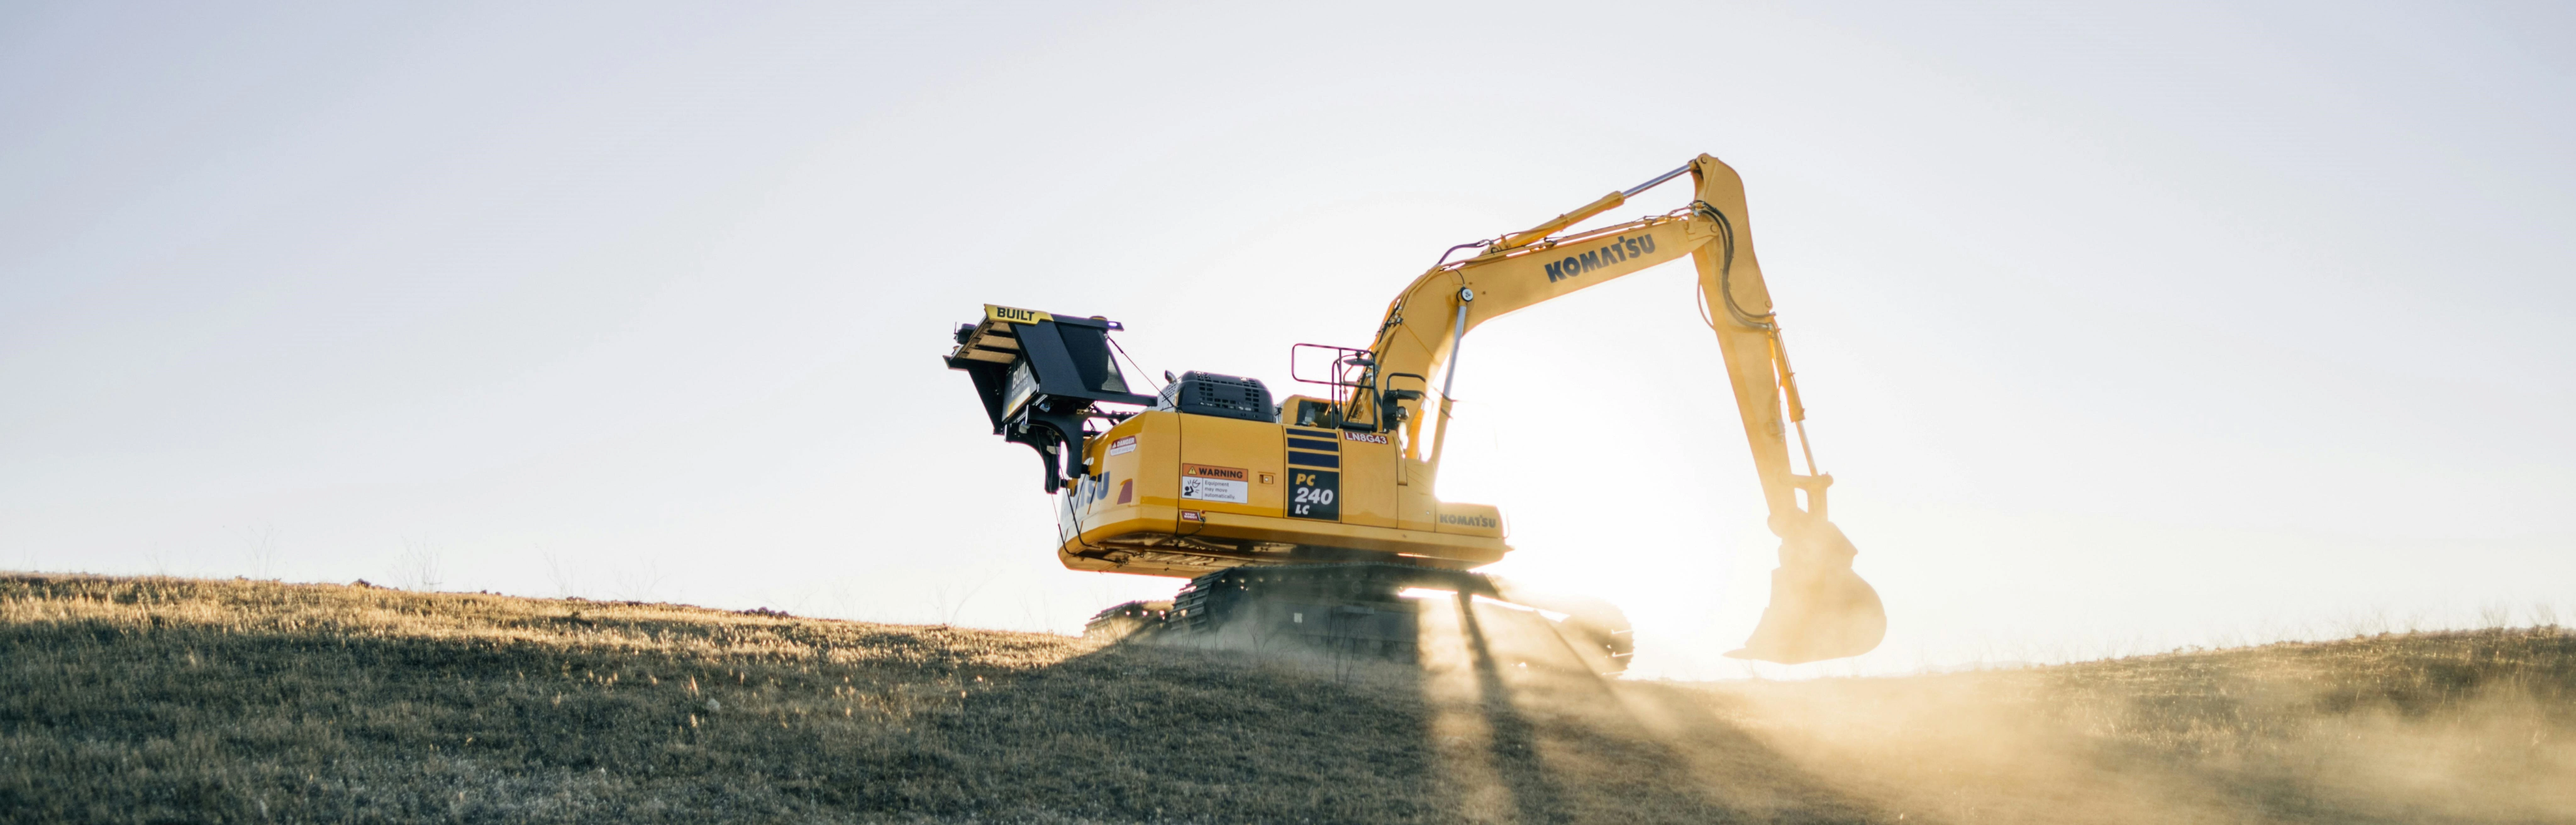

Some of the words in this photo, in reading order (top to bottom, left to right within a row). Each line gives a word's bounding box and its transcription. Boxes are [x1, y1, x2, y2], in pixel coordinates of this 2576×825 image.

[1544, 234, 1656, 283] KOMATSU
[997, 307, 1035, 321] BUILT
[1117, 438, 1135, 447] DANGER
[1345, 432, 1387, 444] LN8G43
[1199, 467, 1243, 479] WARNING
[1295, 473, 1316, 486] PC
[1295, 487, 1334, 505] 240
[1295, 504, 1310, 515] LC
[1439, 514, 1496, 528] KOMATSU
